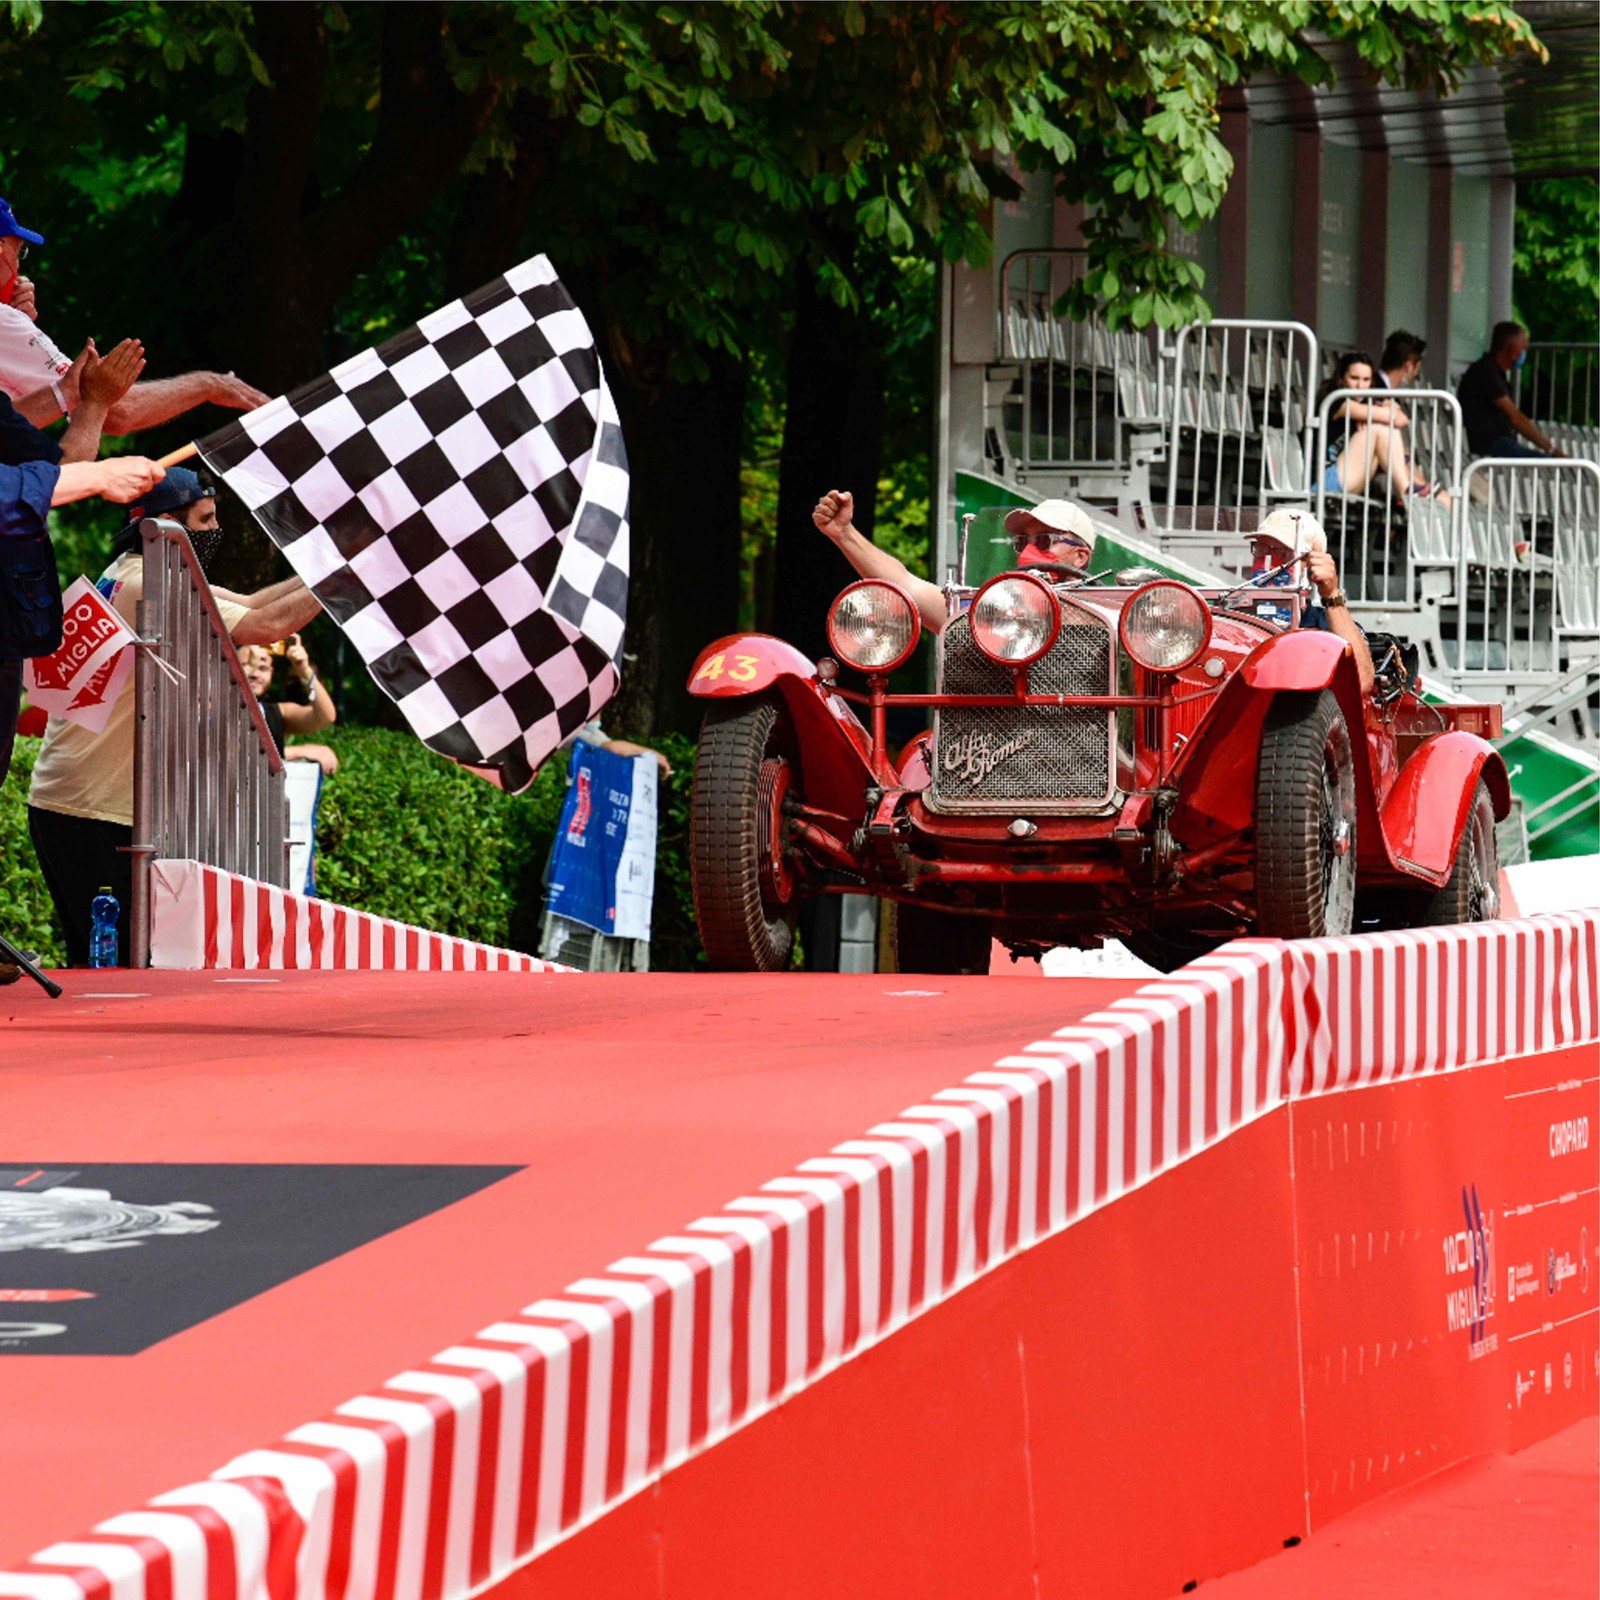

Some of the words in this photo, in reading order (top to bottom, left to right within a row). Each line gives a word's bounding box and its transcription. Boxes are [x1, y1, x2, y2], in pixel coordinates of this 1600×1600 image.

[56, 618, 116, 682] MIGLIA
[695, 654, 760, 682] 43
[944, 729, 992, 779] Alfa
[970, 729, 1035, 786] Romeo
[1549, 1116, 1589, 1158] CHOPARD
[1446, 1284, 1478, 1332] MIGLIA
